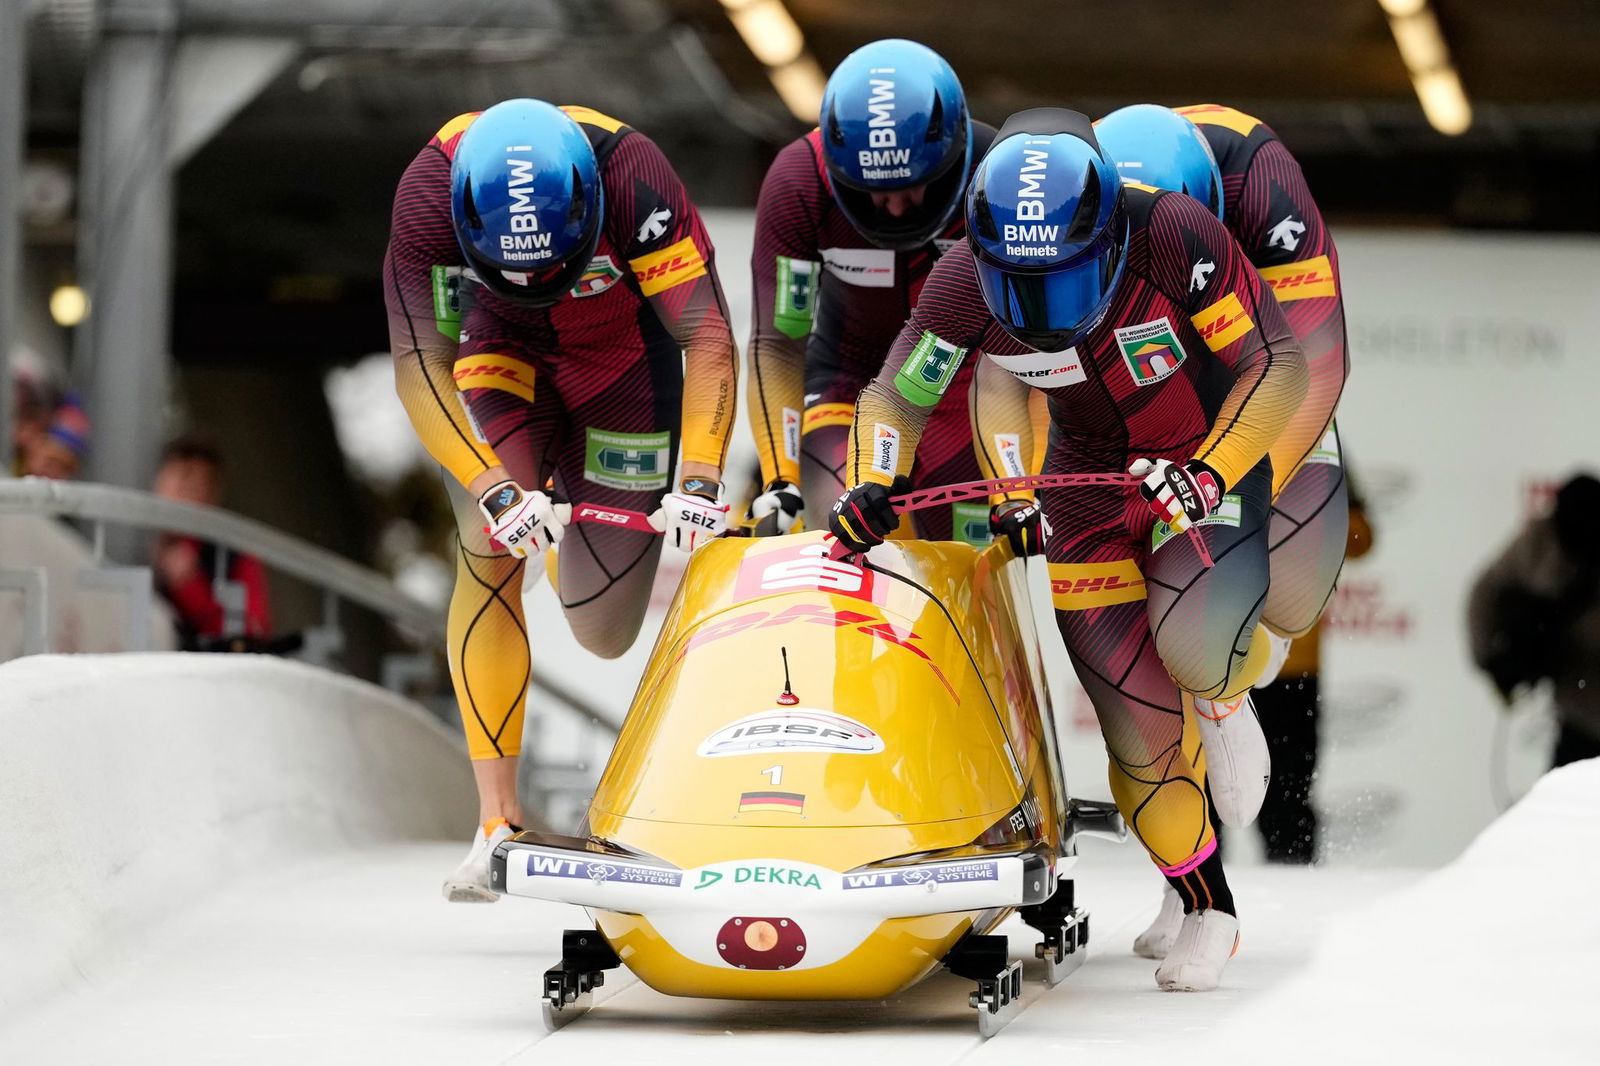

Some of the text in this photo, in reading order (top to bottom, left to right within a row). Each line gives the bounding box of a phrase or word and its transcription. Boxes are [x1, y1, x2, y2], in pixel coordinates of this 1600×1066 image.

[868, 79, 897, 148] BMW
[858, 148, 911, 167] BMW
[862, 166, 912, 179] helmets
[1017, 150, 1049, 221] BMW
[507, 159, 538, 233] BMW
[500, 232, 552, 250] BMW
[1003, 224, 1059, 242] BMW
[503, 249, 552, 261] helmets
[1006, 243, 1058, 256] helmets
[708, 379, 729, 436] BUNDESPOLIZEI
[1170, 471, 1198, 513] SEIZ
[580, 508, 631, 524] FES
[681, 510, 717, 530] SEIZ
[508, 513, 541, 546] SEIZ
[1050, 575, 1130, 595] DHL
[731, 724, 854, 740] IBSF
[760, 764, 784, 786] 1
[1009, 810, 1026, 834] FES
[532, 856, 676, 879] WT ENERGIE
[847, 863, 991, 888] WT ENERGIE
[936, 869, 994, 882] SYSTEME
[620, 872, 677, 886] SYSTEME
[734, 866, 822, 890] DEKRA
